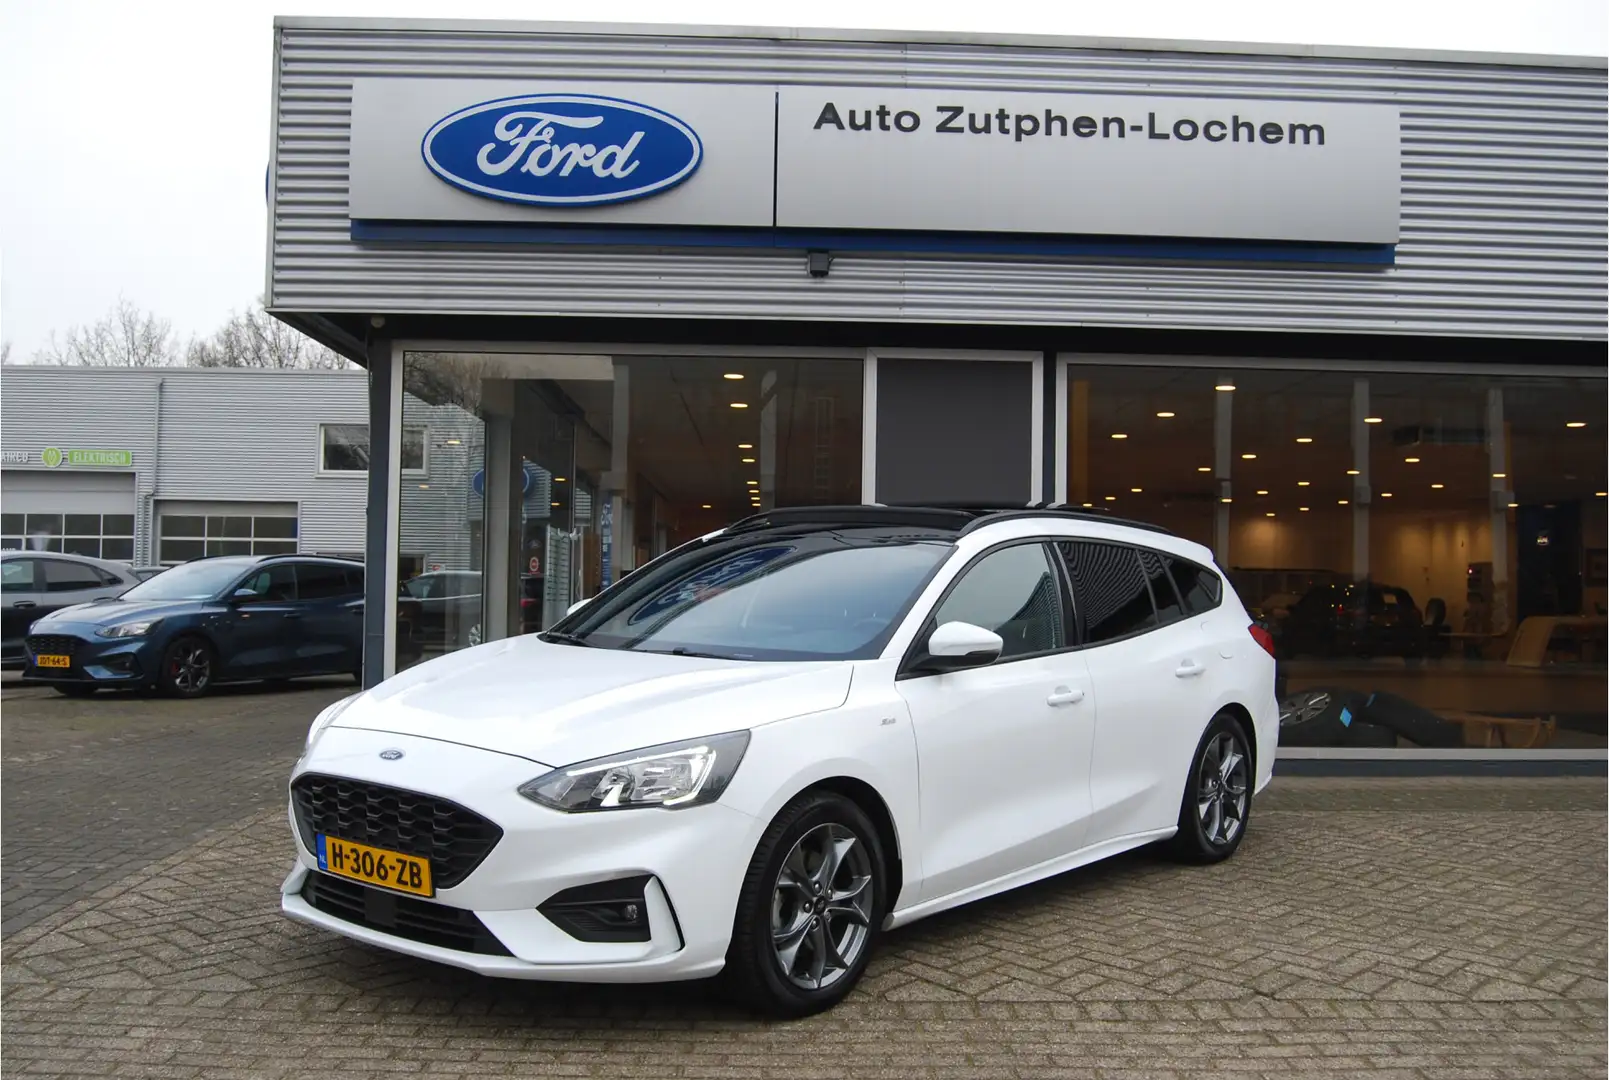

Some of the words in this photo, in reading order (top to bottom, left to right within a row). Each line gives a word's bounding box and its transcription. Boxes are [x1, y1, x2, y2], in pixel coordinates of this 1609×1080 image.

[477, 111, 645, 178] Ford
[813, 102, 921, 133] Auto
[936, 106, 1325, 145] Zutphen-Lochem
[73, 451, 127, 464] ELEKTRISCH
[332, 842, 422, 888] H-306-ZB
